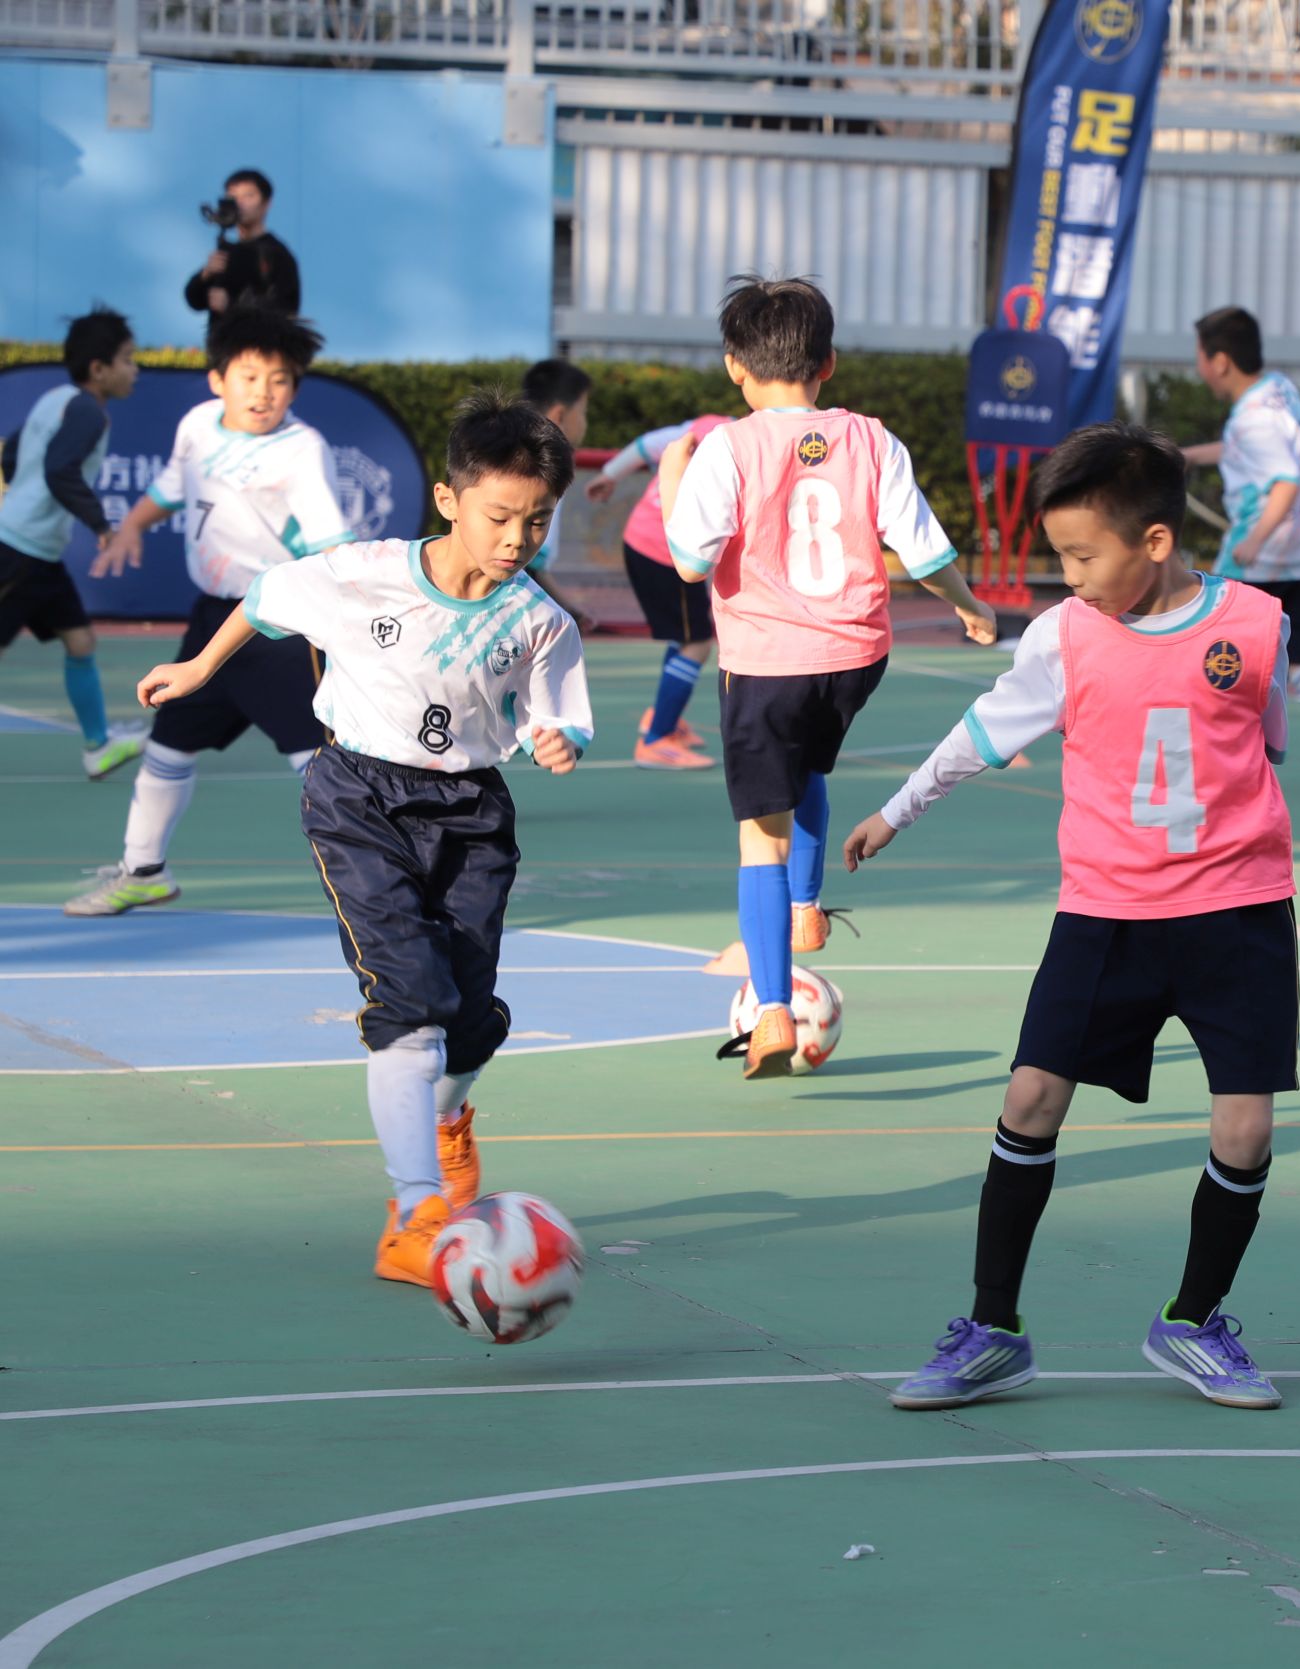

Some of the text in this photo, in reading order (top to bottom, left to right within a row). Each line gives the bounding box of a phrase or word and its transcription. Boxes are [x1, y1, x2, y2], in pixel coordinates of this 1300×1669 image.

[1050, 84, 1073, 126] PUT
[1045, 125, 1067, 169] OUR
[1039, 168, 1061, 217] BEST
[1032, 218, 1055, 270] FOOT
[195, 499, 215, 541] 7
[786, 477, 846, 597] 8
[417, 703, 454, 755] 8
[1130, 707, 1207, 854] 4
